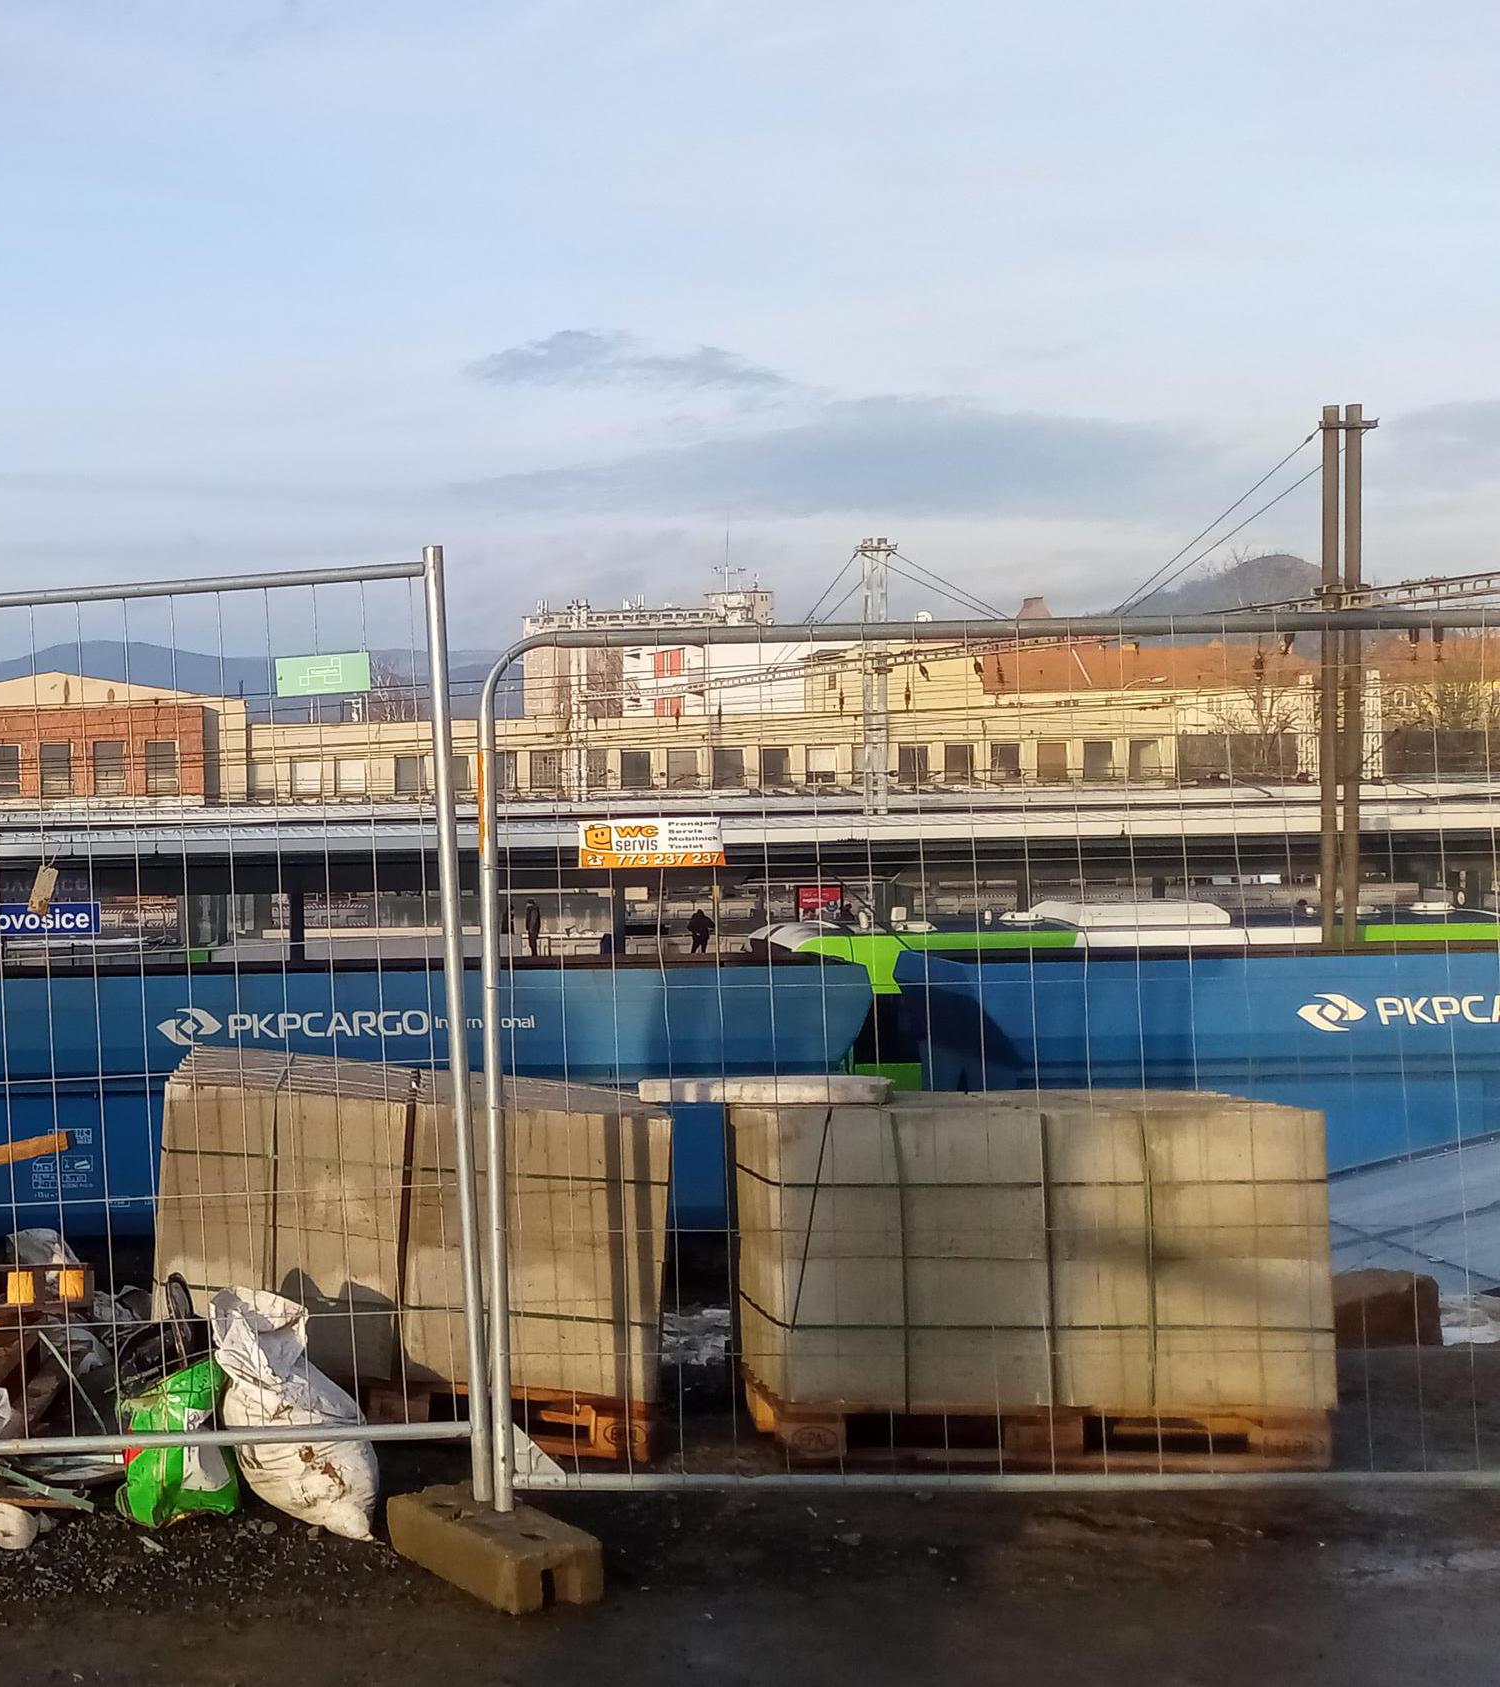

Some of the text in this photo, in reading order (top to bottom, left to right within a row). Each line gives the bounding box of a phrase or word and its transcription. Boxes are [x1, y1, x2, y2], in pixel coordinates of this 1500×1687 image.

[615, 825, 659, 838] WC
[615, 838, 658, 852] servis
[616, 853, 719, 866] 773 237 237
[228, 1010, 535, 1039] PKPCARGO Inrnonal
